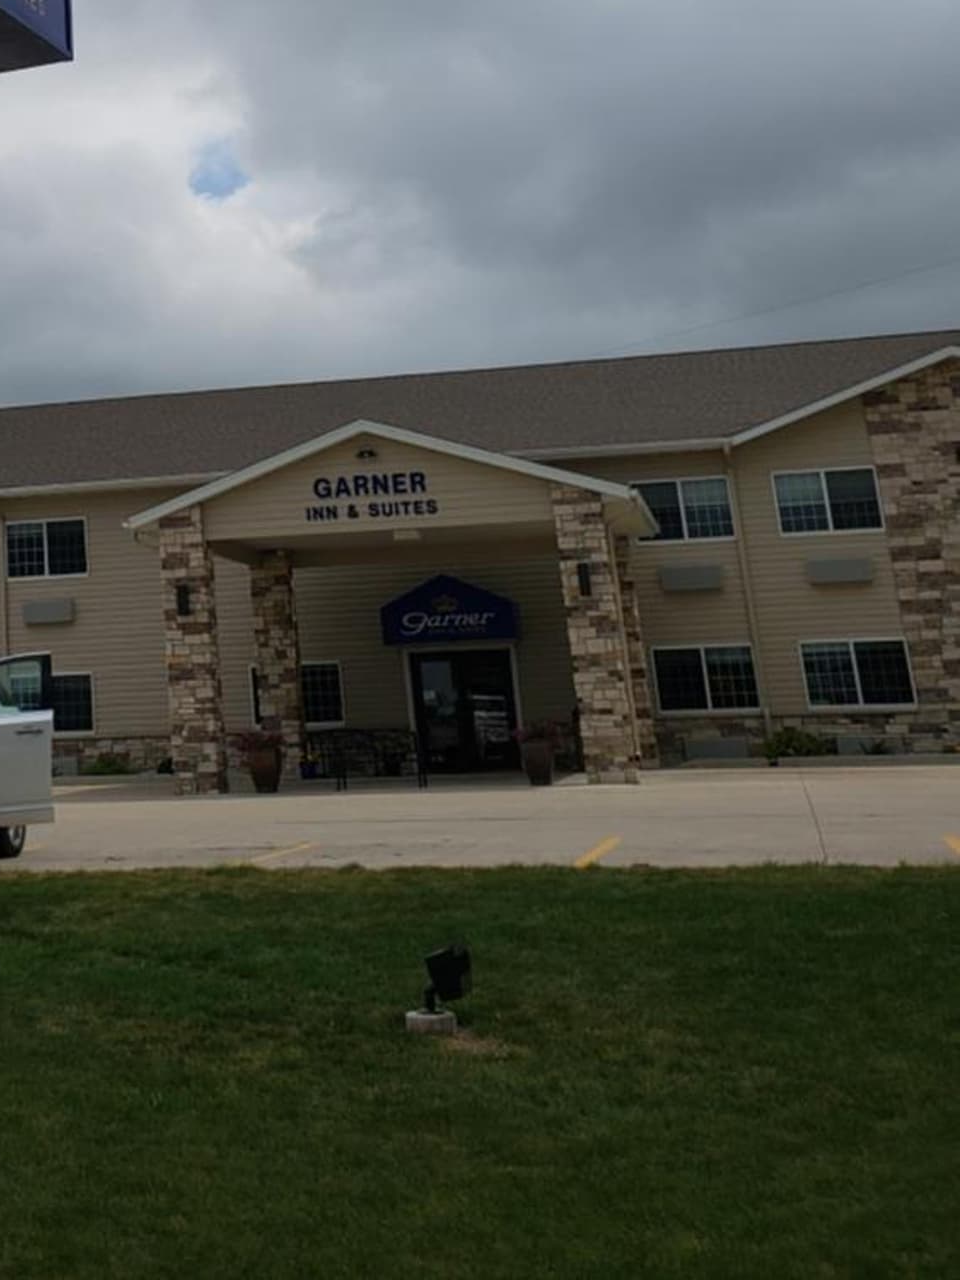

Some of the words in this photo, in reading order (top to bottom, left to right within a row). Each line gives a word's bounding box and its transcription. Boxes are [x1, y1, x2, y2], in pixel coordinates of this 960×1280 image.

[313, 471, 427, 499] GARNER
[305, 505, 338, 521] INN
[346, 503, 359, 519] &
[367, 499, 439, 518] SUITES
[400, 611, 496, 636] Garner
